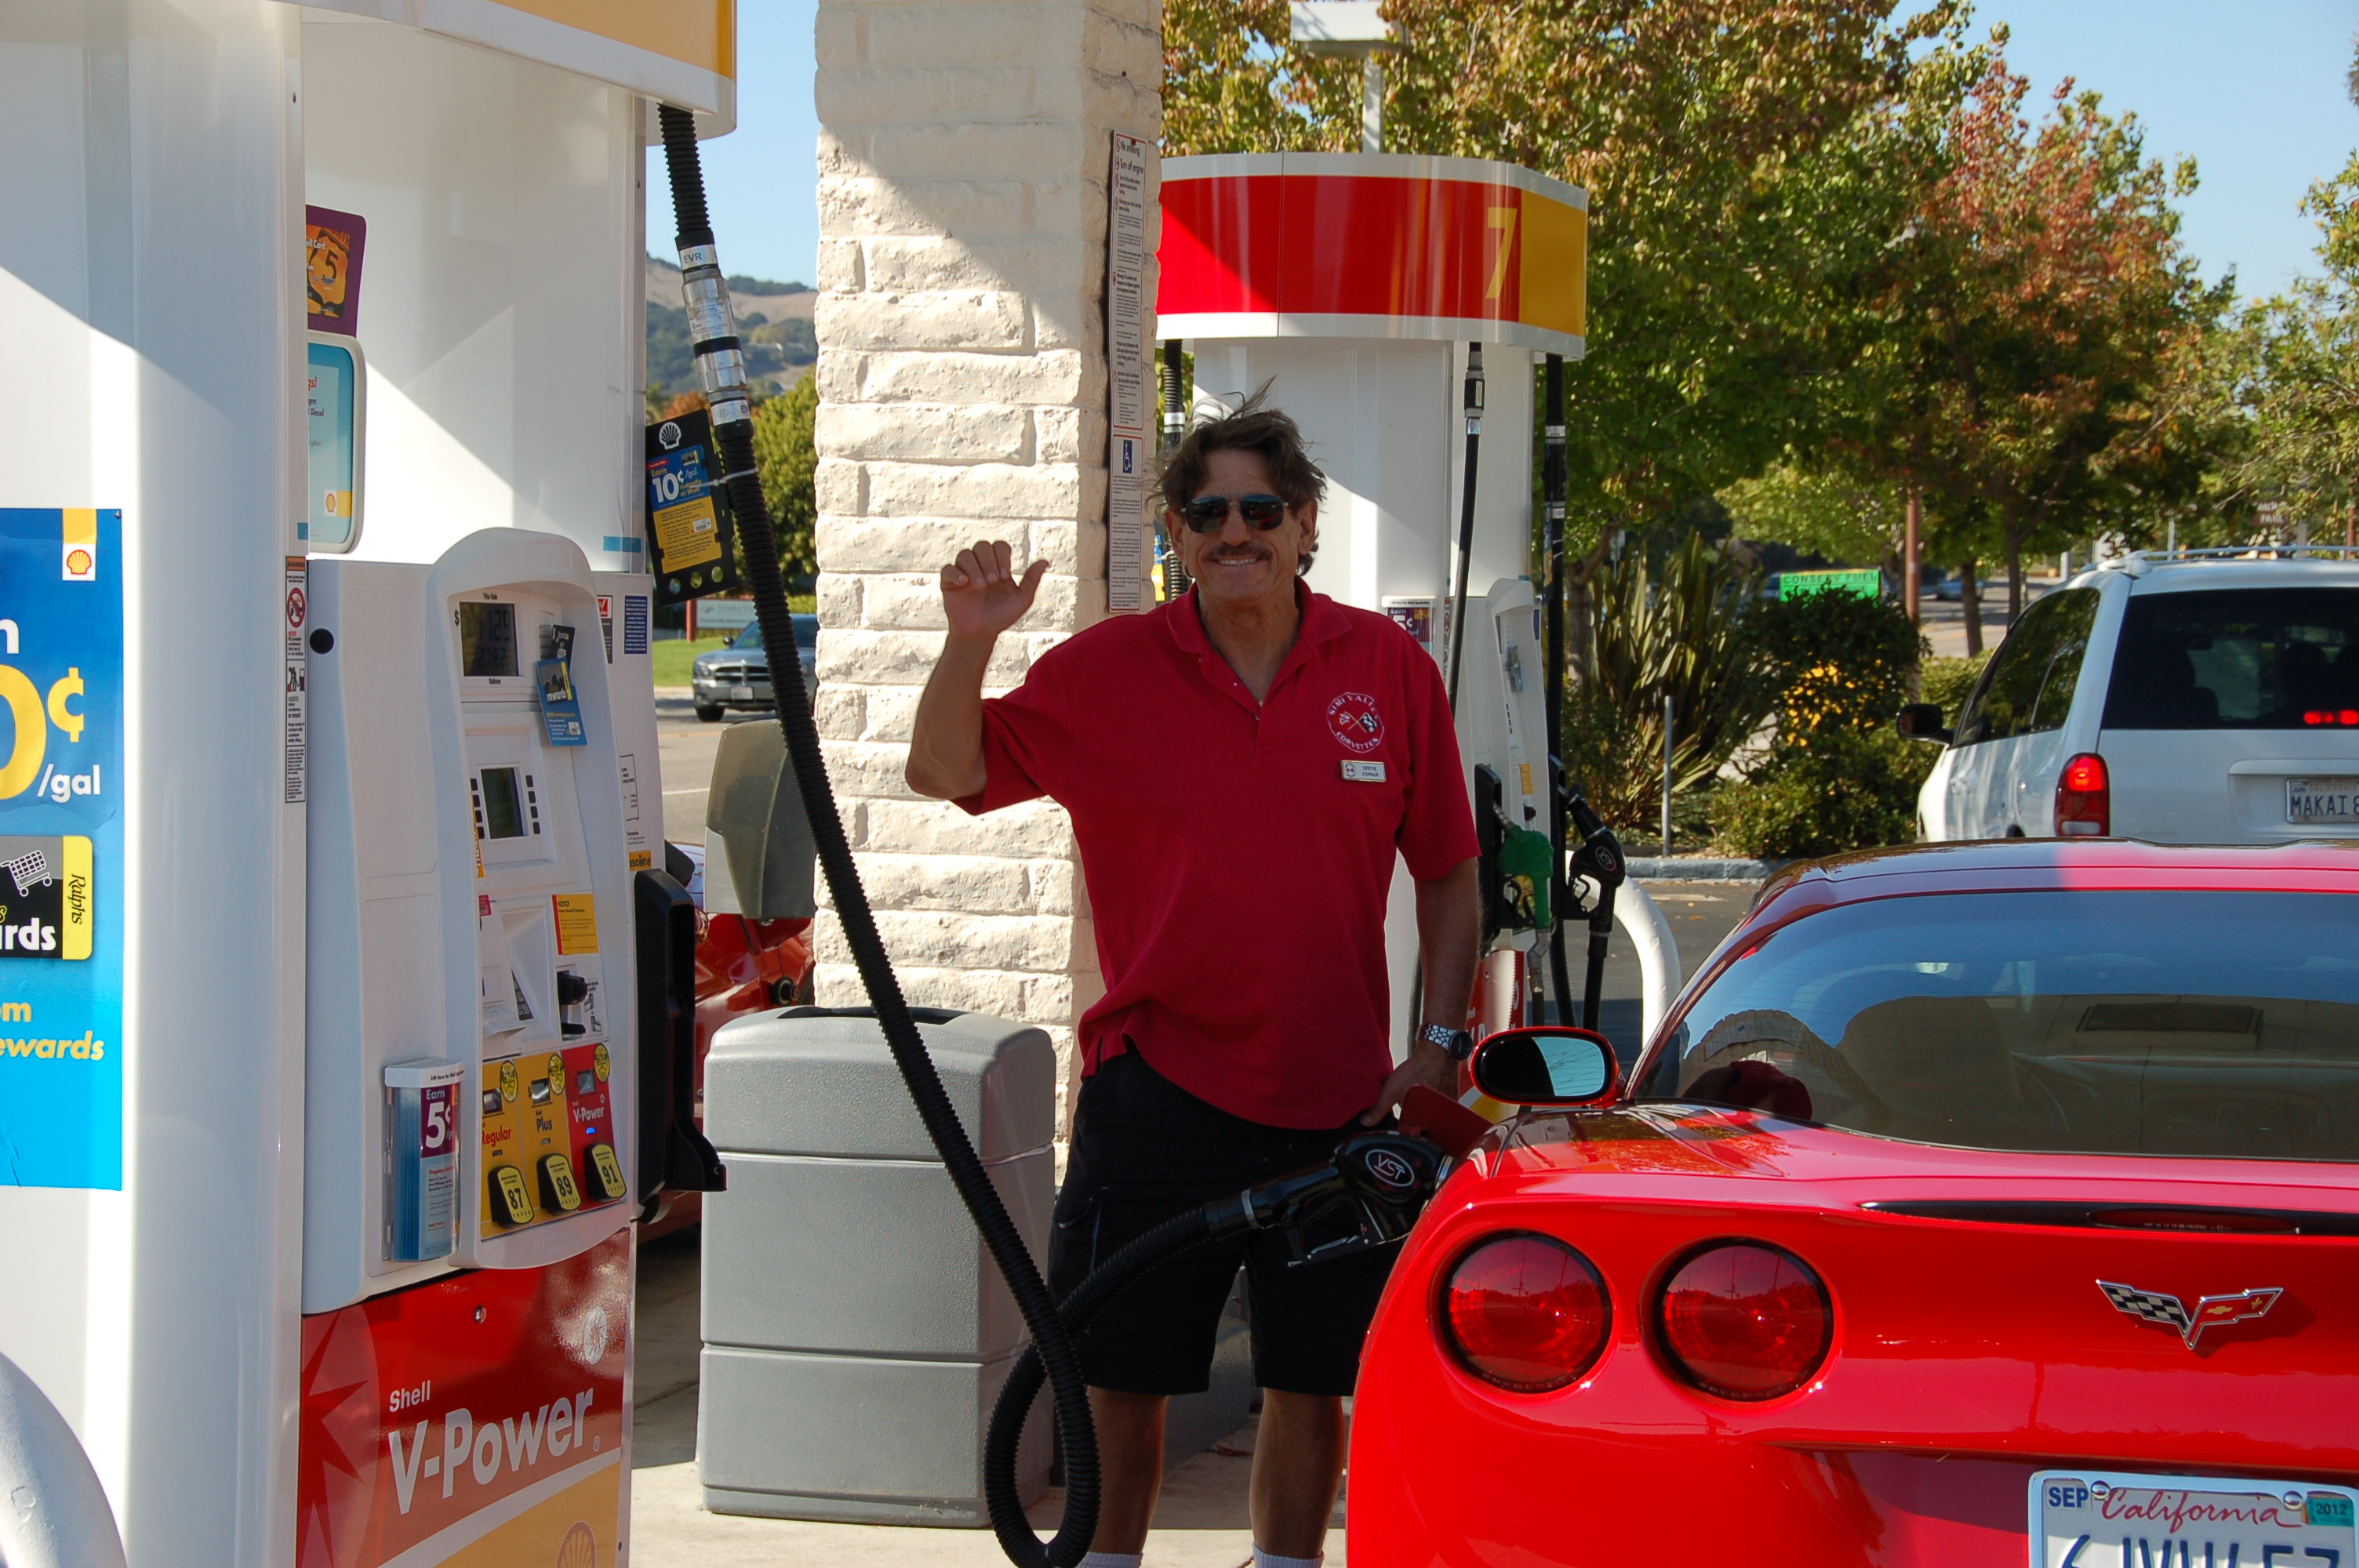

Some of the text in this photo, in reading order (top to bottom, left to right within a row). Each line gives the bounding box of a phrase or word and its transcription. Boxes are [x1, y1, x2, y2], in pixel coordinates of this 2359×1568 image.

[684, 252, 703, 264] EVR
[1485, 206, 1518, 299] 7
[454, 610, 460, 626] $
[1329, 697, 1346, 715] SIMI
[1336, 731, 1379, 750] CORVETTES
[2290, 794, 2348, 816] MAKAI
[67, 873, 86, 925] Ralphs
[0, 917, 56, 951] rds
[426, 1088, 445, 1101] Earn
[536, 1116, 553, 1134] Plus
[572, 1106, 605, 1123] V-Power
[601, 1163, 619, 1185] 91
[1373, 1153, 1405, 1180] VST
[556, 1174, 573, 1197] 89
[507, 1187, 524, 1210] 87
[389, 1379, 431, 1413] Shell
[387, 1387, 594, 1515] V-Power
[2048, 1486, 2347, 1534] SEP California 2012
